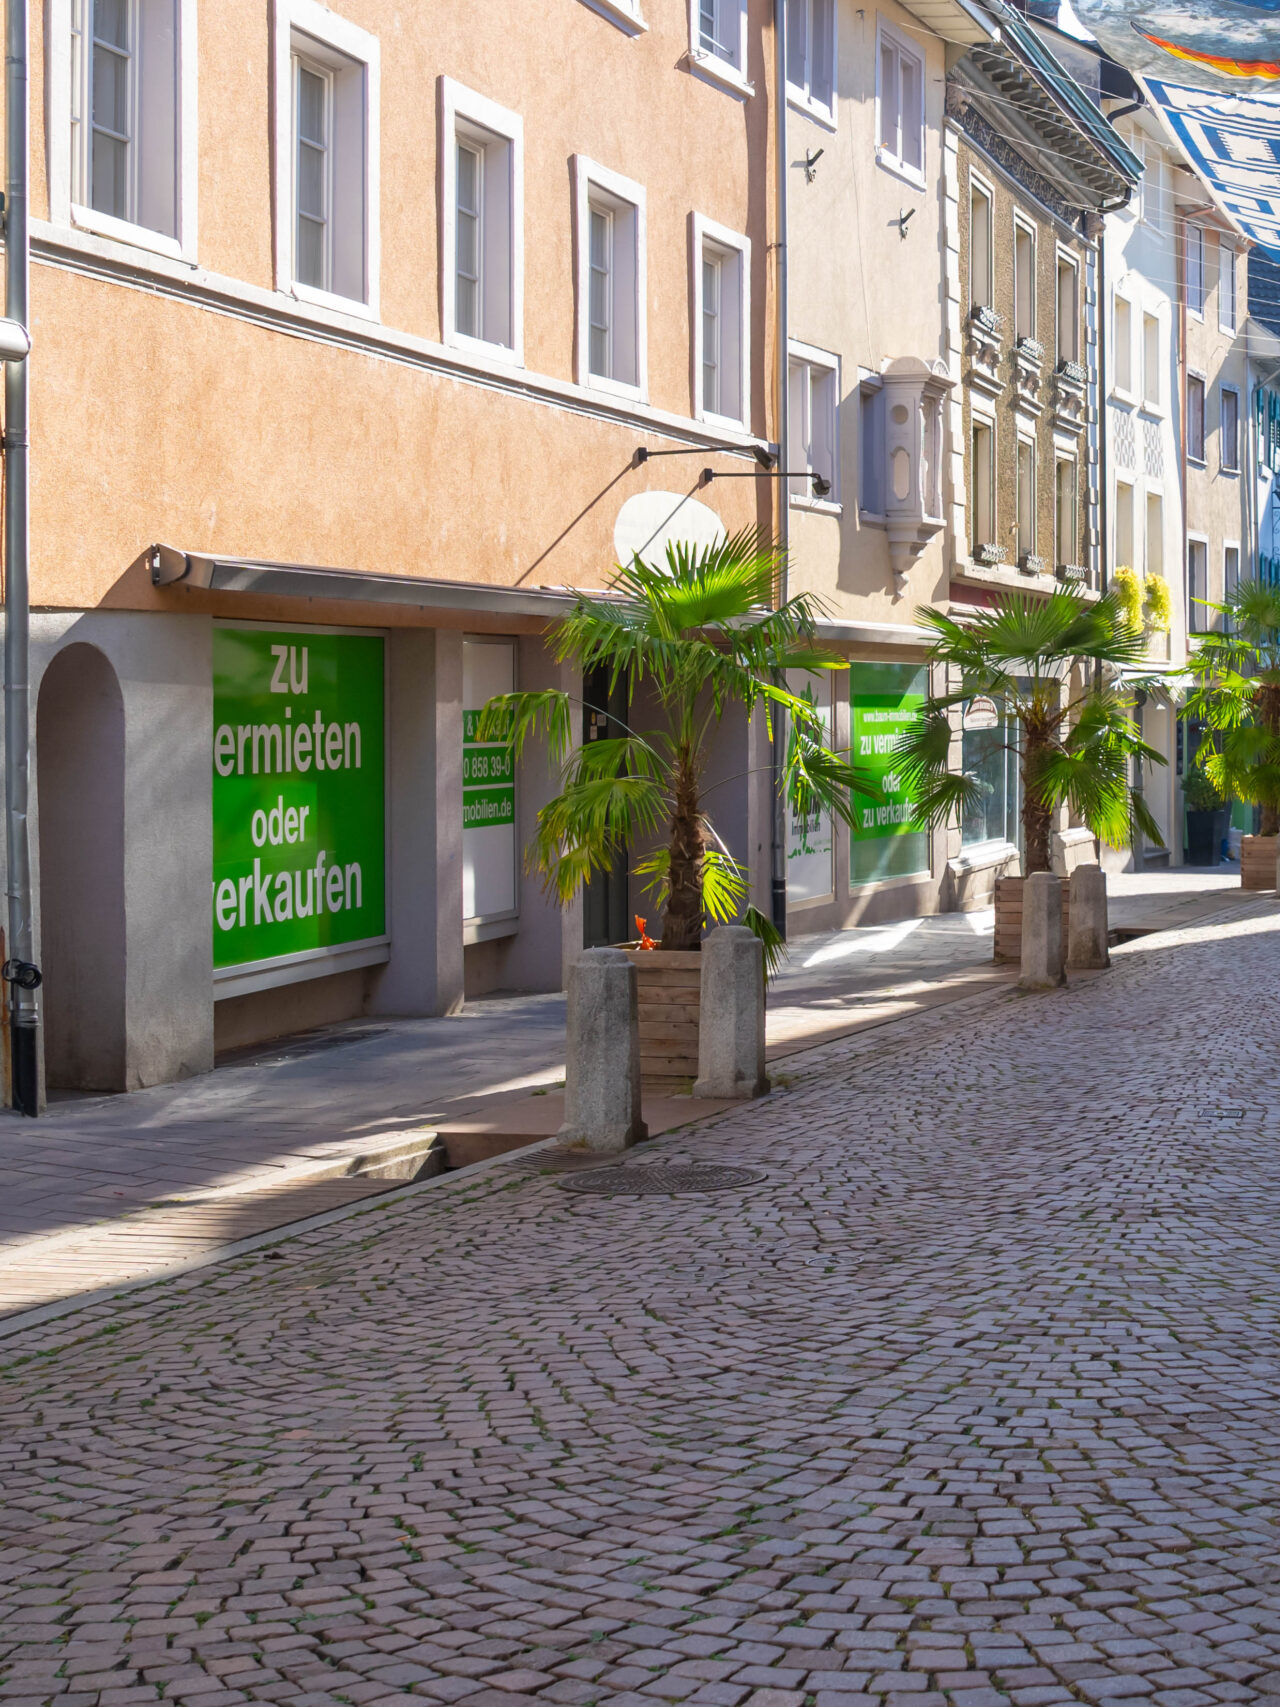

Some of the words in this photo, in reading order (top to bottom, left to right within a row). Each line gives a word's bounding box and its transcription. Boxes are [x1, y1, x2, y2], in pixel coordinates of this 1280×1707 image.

[270, 644, 308, 695] zu
[213, 706, 362, 777] ermieten
[471, 756, 489, 778] 858
[490, 755, 511, 777] 39-0
[860, 735, 872, 755] zu
[251, 795, 310, 848] oder
[863, 808, 874, 828] zu
[213, 850, 363, 932] erkaufen
